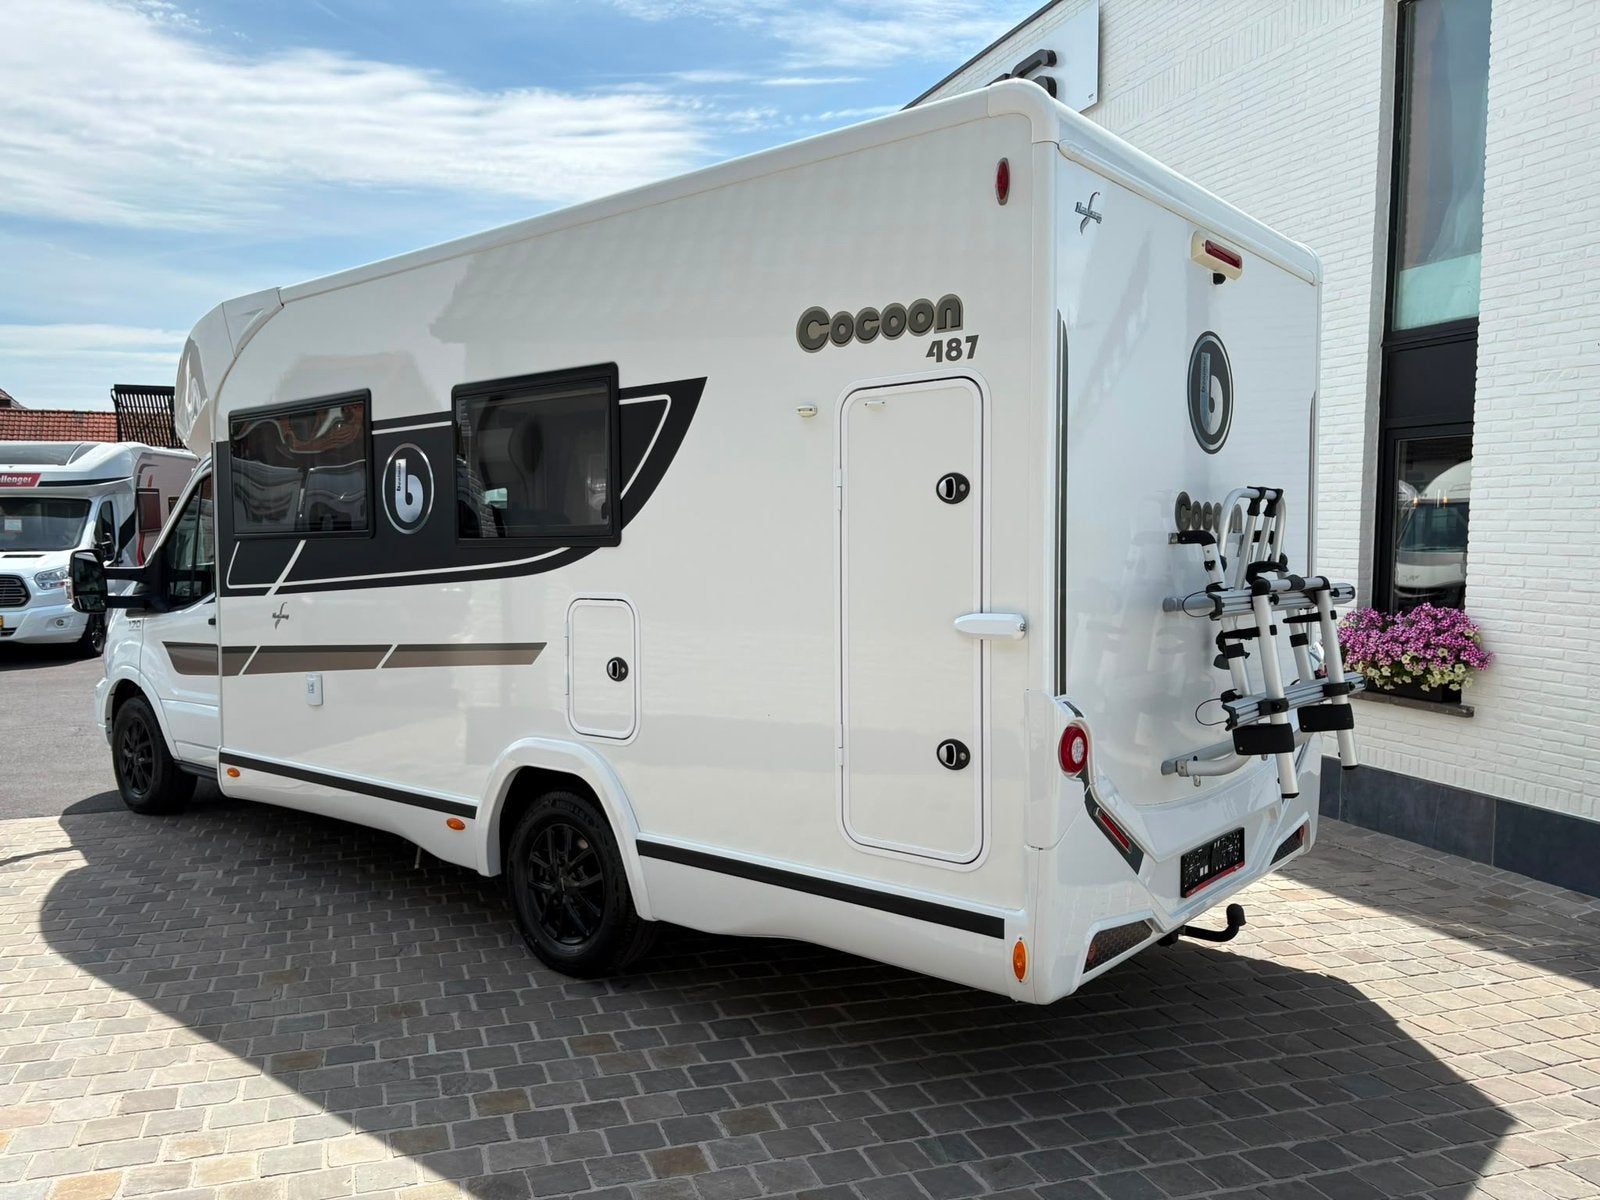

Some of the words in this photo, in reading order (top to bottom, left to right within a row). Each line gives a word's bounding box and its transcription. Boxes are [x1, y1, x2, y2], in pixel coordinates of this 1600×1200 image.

[796, 293, 963, 353] Cocoon
[926, 335, 979, 363] 487
[0, 475, 33, 485] llenger
[1175, 491, 1242, 534] Cocon
